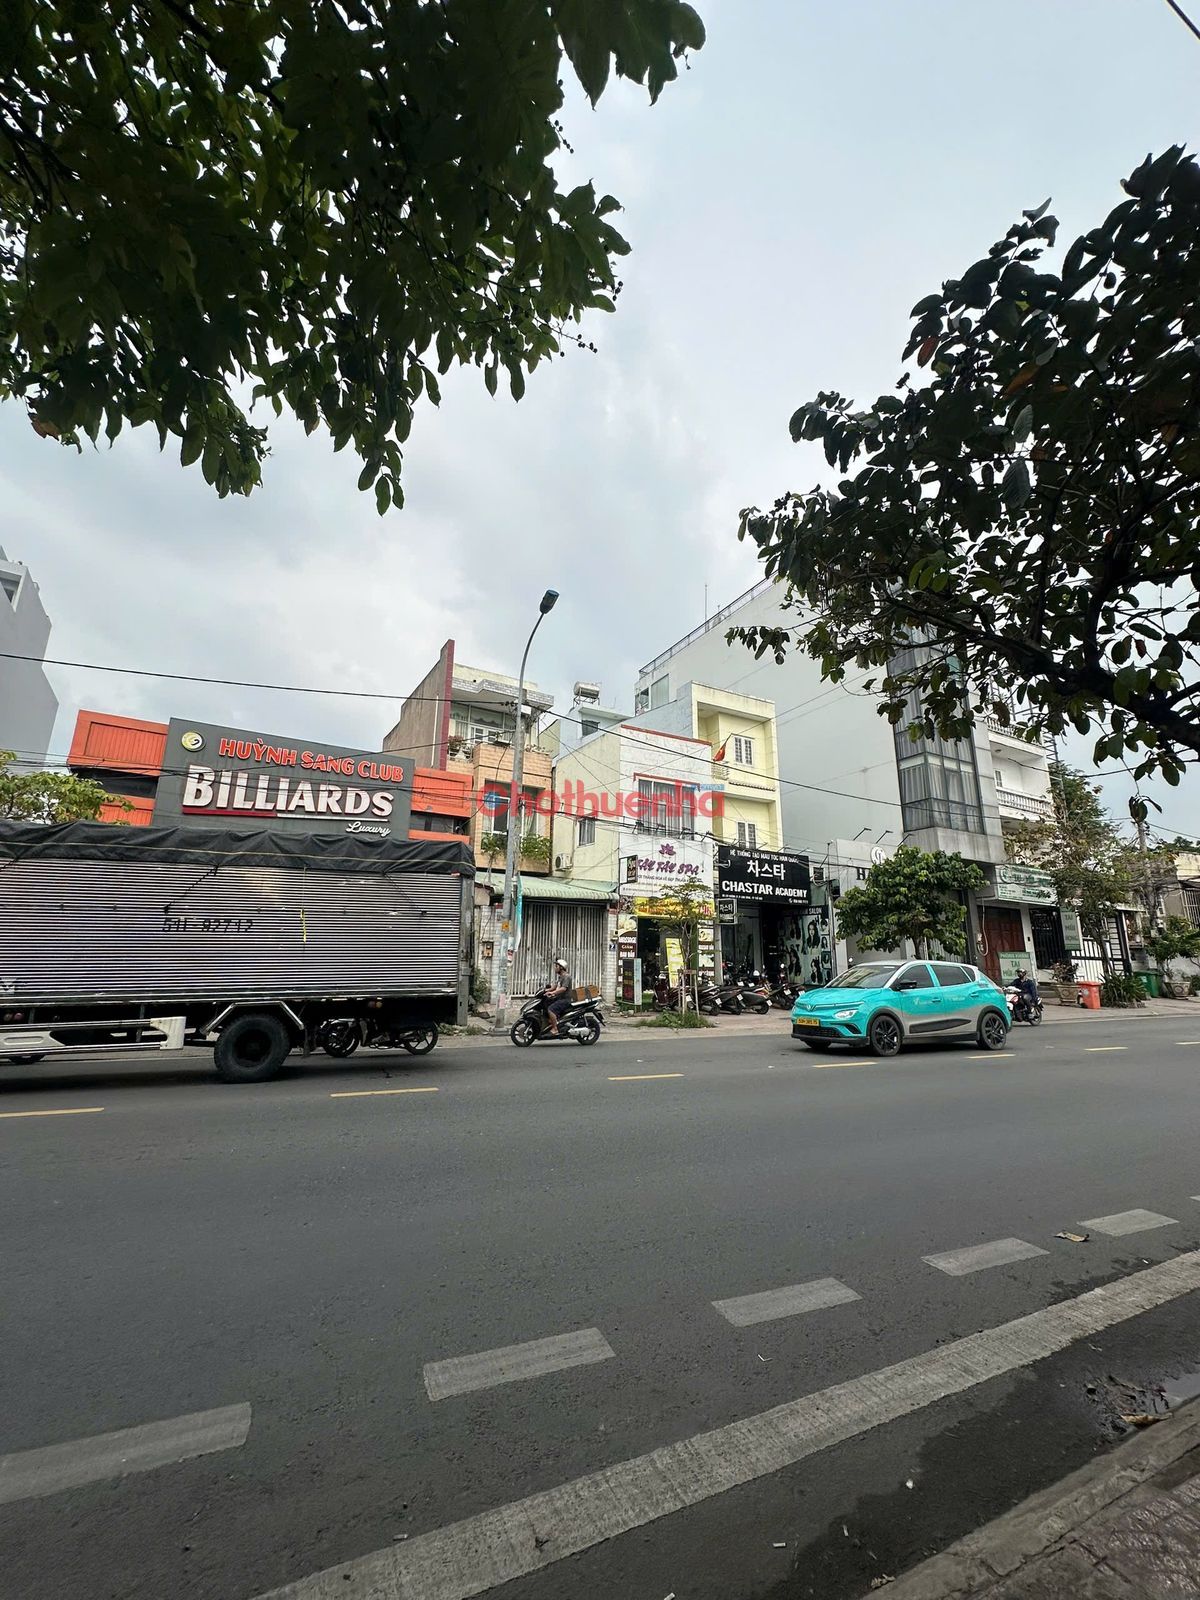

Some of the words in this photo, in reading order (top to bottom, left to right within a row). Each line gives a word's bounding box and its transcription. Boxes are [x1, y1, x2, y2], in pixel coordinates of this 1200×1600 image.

[218, 738, 297, 767] HUỲNH
[300, 750, 355, 776] SANG
[357, 760, 405, 782] CLUB
[182, 764, 395, 817] BILLIARDS
[345, 821, 392, 837] Luxury
[677, 863, 700, 876] SPA
[747, 860, 786, 881] 차스타
[722, 881, 773, 895] CHASTAR
[775, 887, 808, 898] ACADEMY
